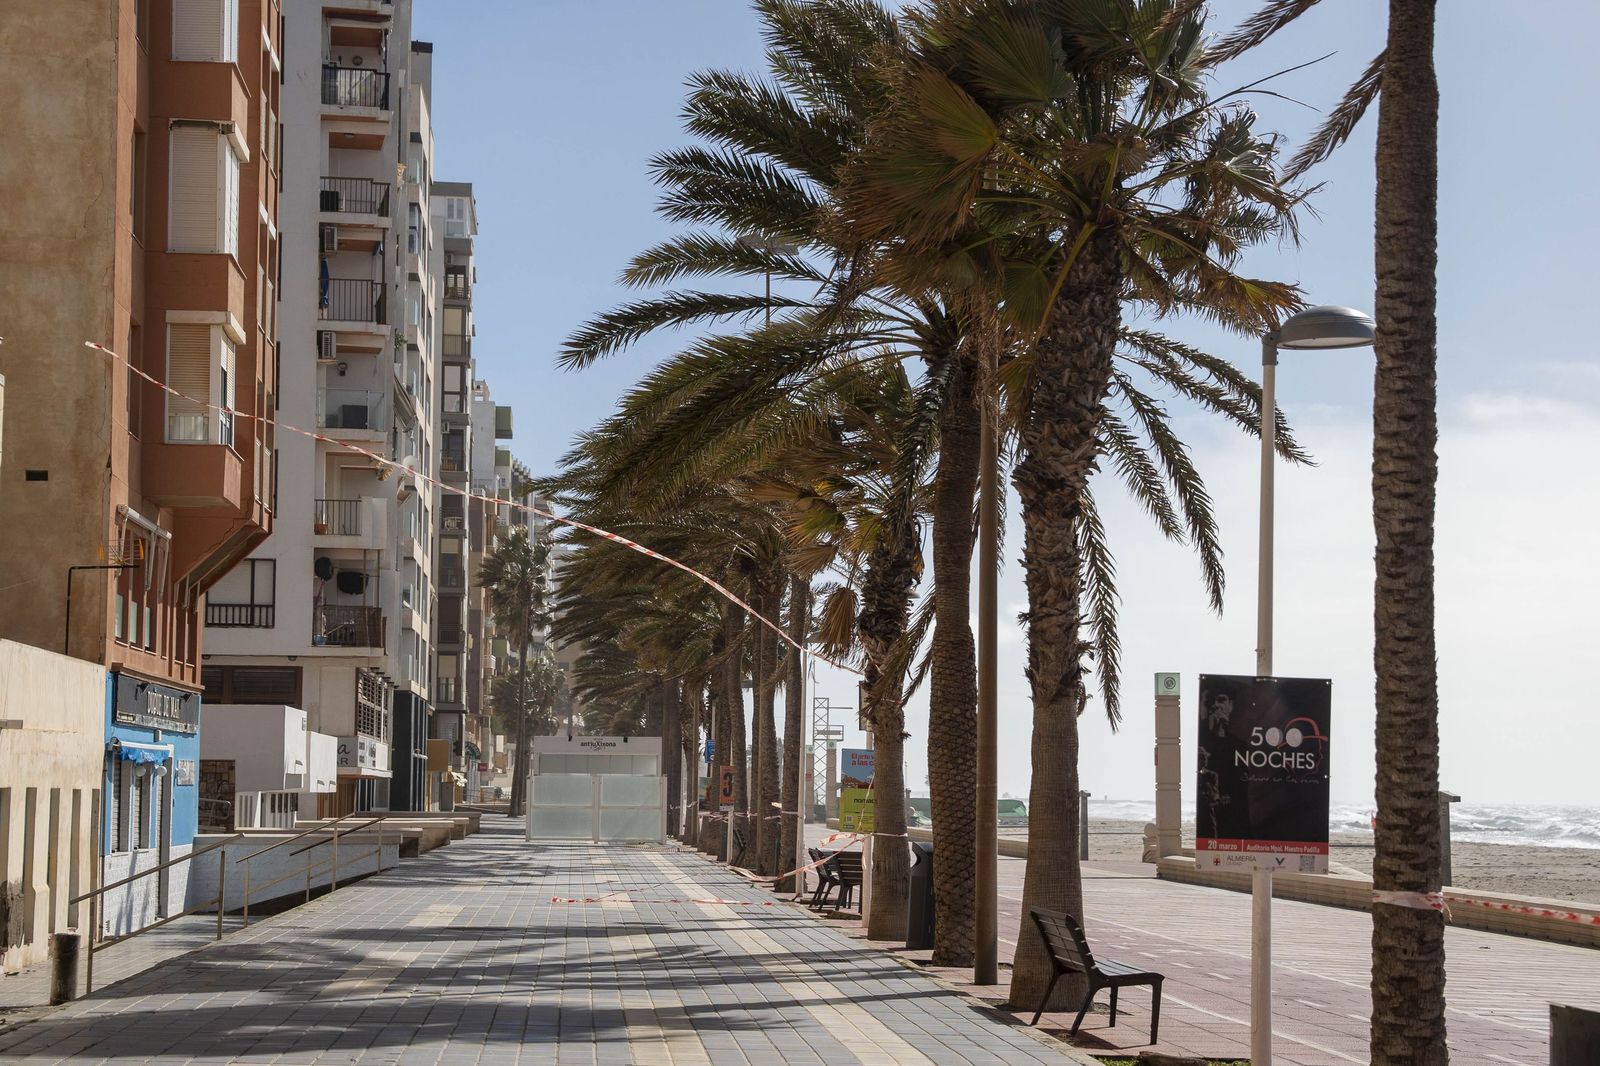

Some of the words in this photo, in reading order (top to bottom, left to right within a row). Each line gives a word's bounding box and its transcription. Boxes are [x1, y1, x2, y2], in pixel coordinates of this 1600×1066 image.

[1250, 726, 1303, 748] 500
[1234, 750, 1315, 770] NOCHES
[1208, 839, 1217, 849] 20
[1284, 845, 1303, 853] Maestro
